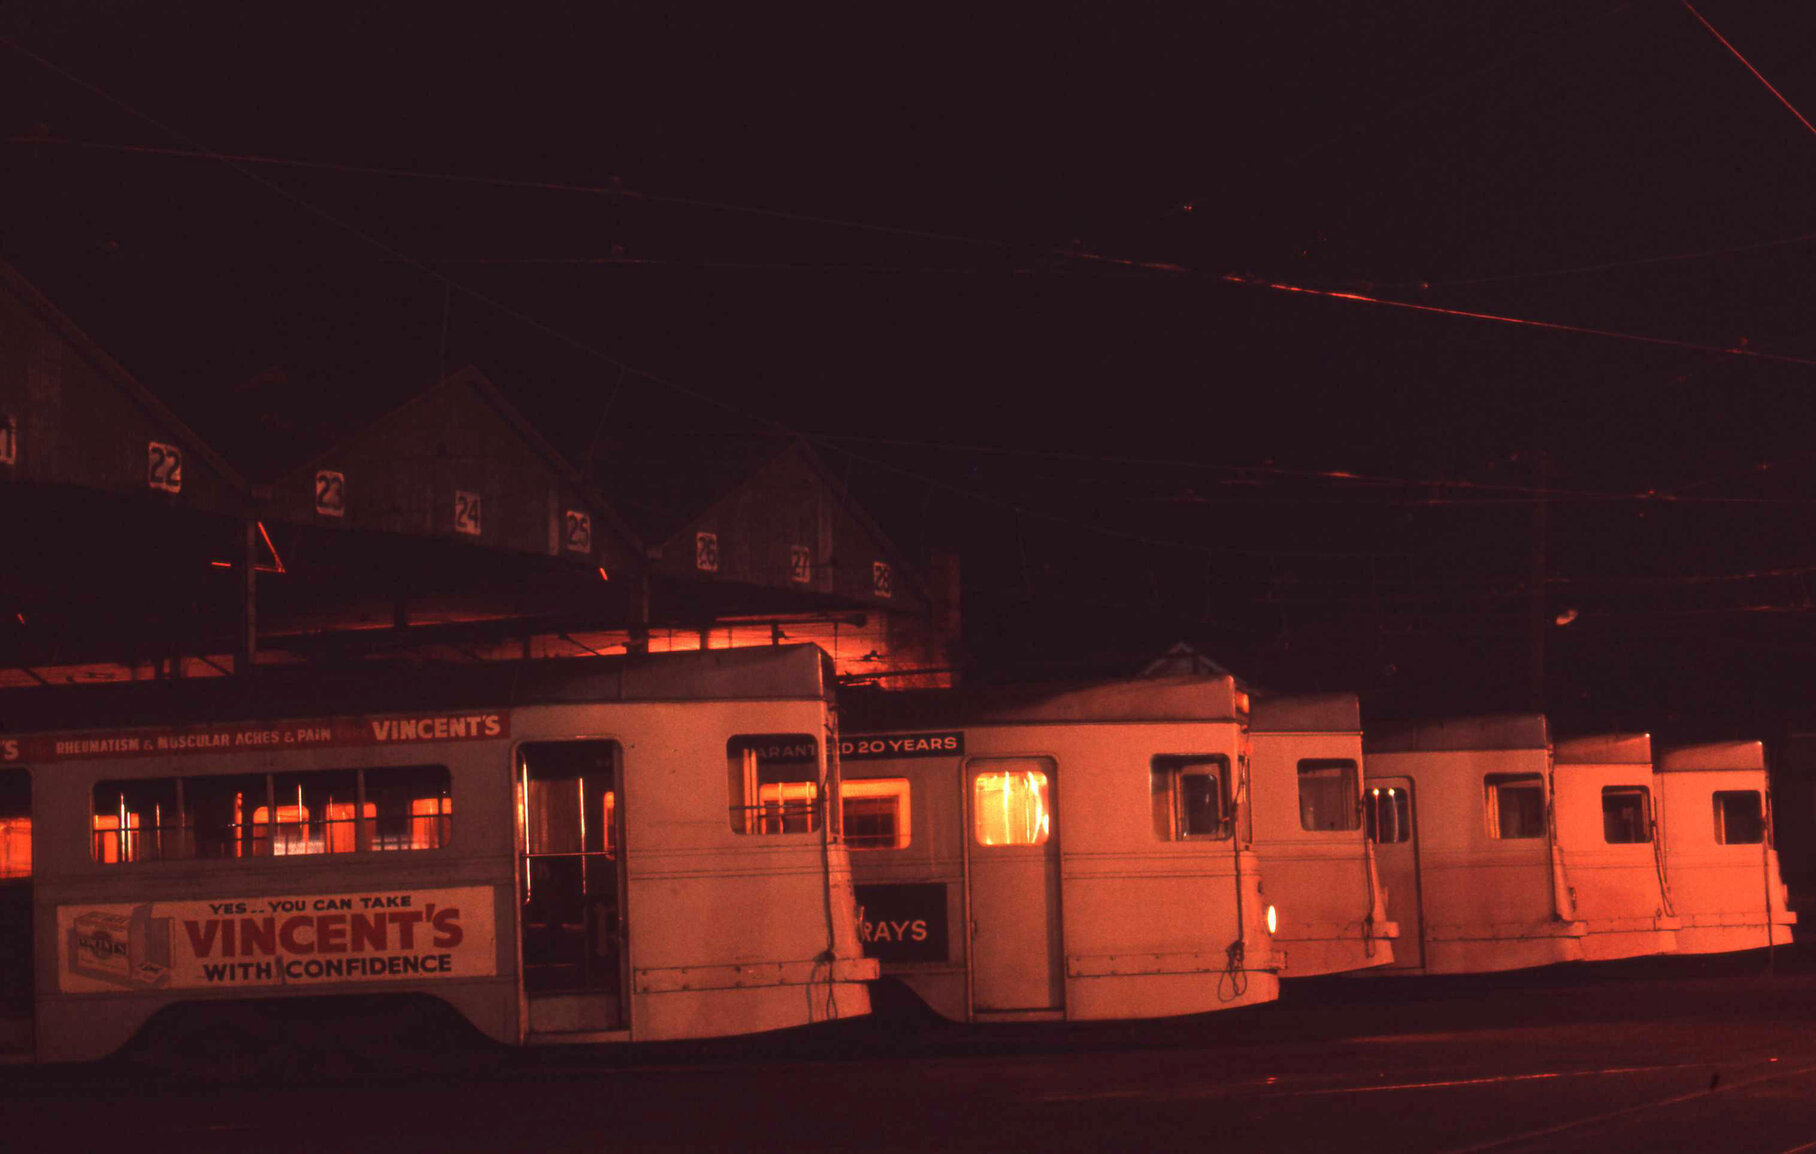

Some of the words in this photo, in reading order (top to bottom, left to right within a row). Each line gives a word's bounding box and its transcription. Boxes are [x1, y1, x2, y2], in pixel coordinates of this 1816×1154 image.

[149, 445, 180, 488] 22
[317, 474, 345, 512] 23
[457, 494, 480, 530] 24
[567, 513, 590, 551] 25
[56, 738, 140, 755] RHEUMATISM
[157, 733, 231, 749] MUSCULAR
[235, 731, 280, 745] ACHES
[284, 731, 295, 743] &
[297, 728, 332, 742] PAIN
[372, 715, 501, 741] VINCENT'S
[858, 740, 885, 754] 20
[889, 737, 958, 752] YEARS
[268, 900, 306, 914] YOU
[313, 898, 352, 912] CAN
[360, 896, 411, 909] TAKE
[185, 903, 464, 959] VINCENT'S
[203, 961, 271, 982] WITH
[285, 954, 452, 979] CONFIDENCE
